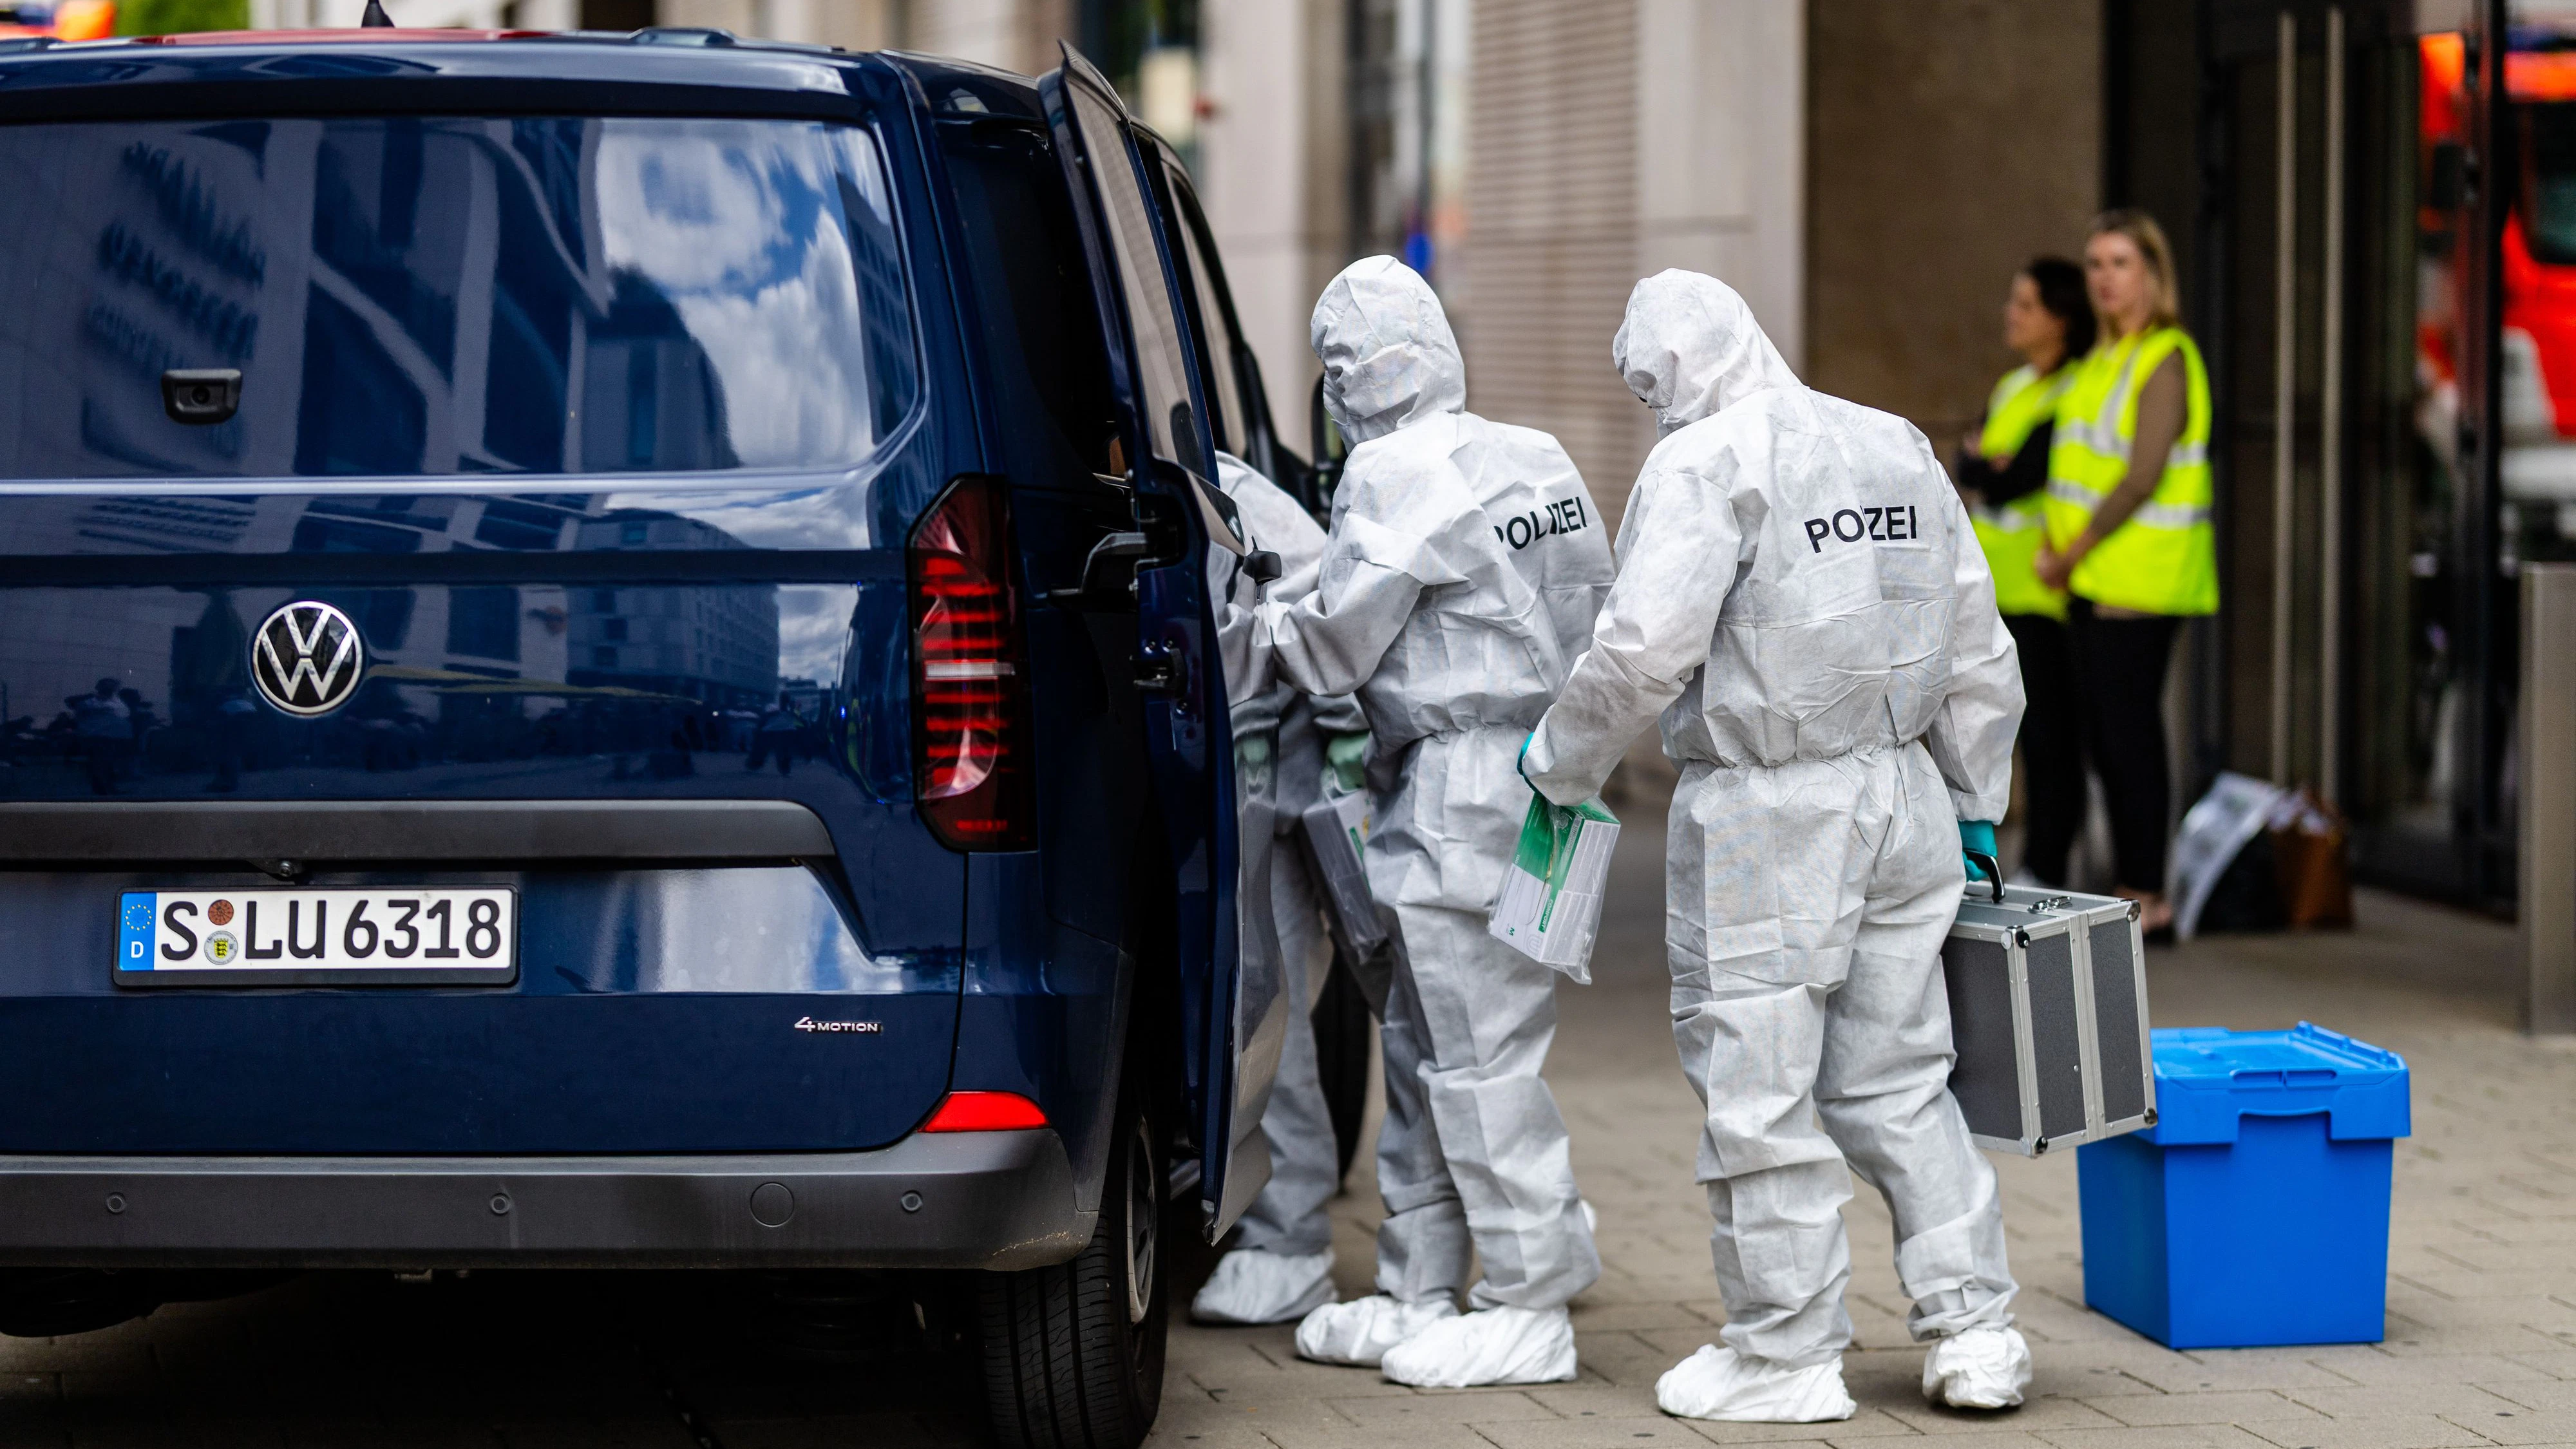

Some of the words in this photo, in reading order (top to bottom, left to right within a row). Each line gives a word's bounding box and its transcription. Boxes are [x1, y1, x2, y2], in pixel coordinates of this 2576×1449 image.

[1541, 899, 1553, 930] COMFORT
[160, 902, 198, 961] S
[245, 900, 327, 960] LU
[343, 899, 500, 959] 6318
[131, 941, 144, 958] D
[794, 1016, 878, 1032] 4MOTION
